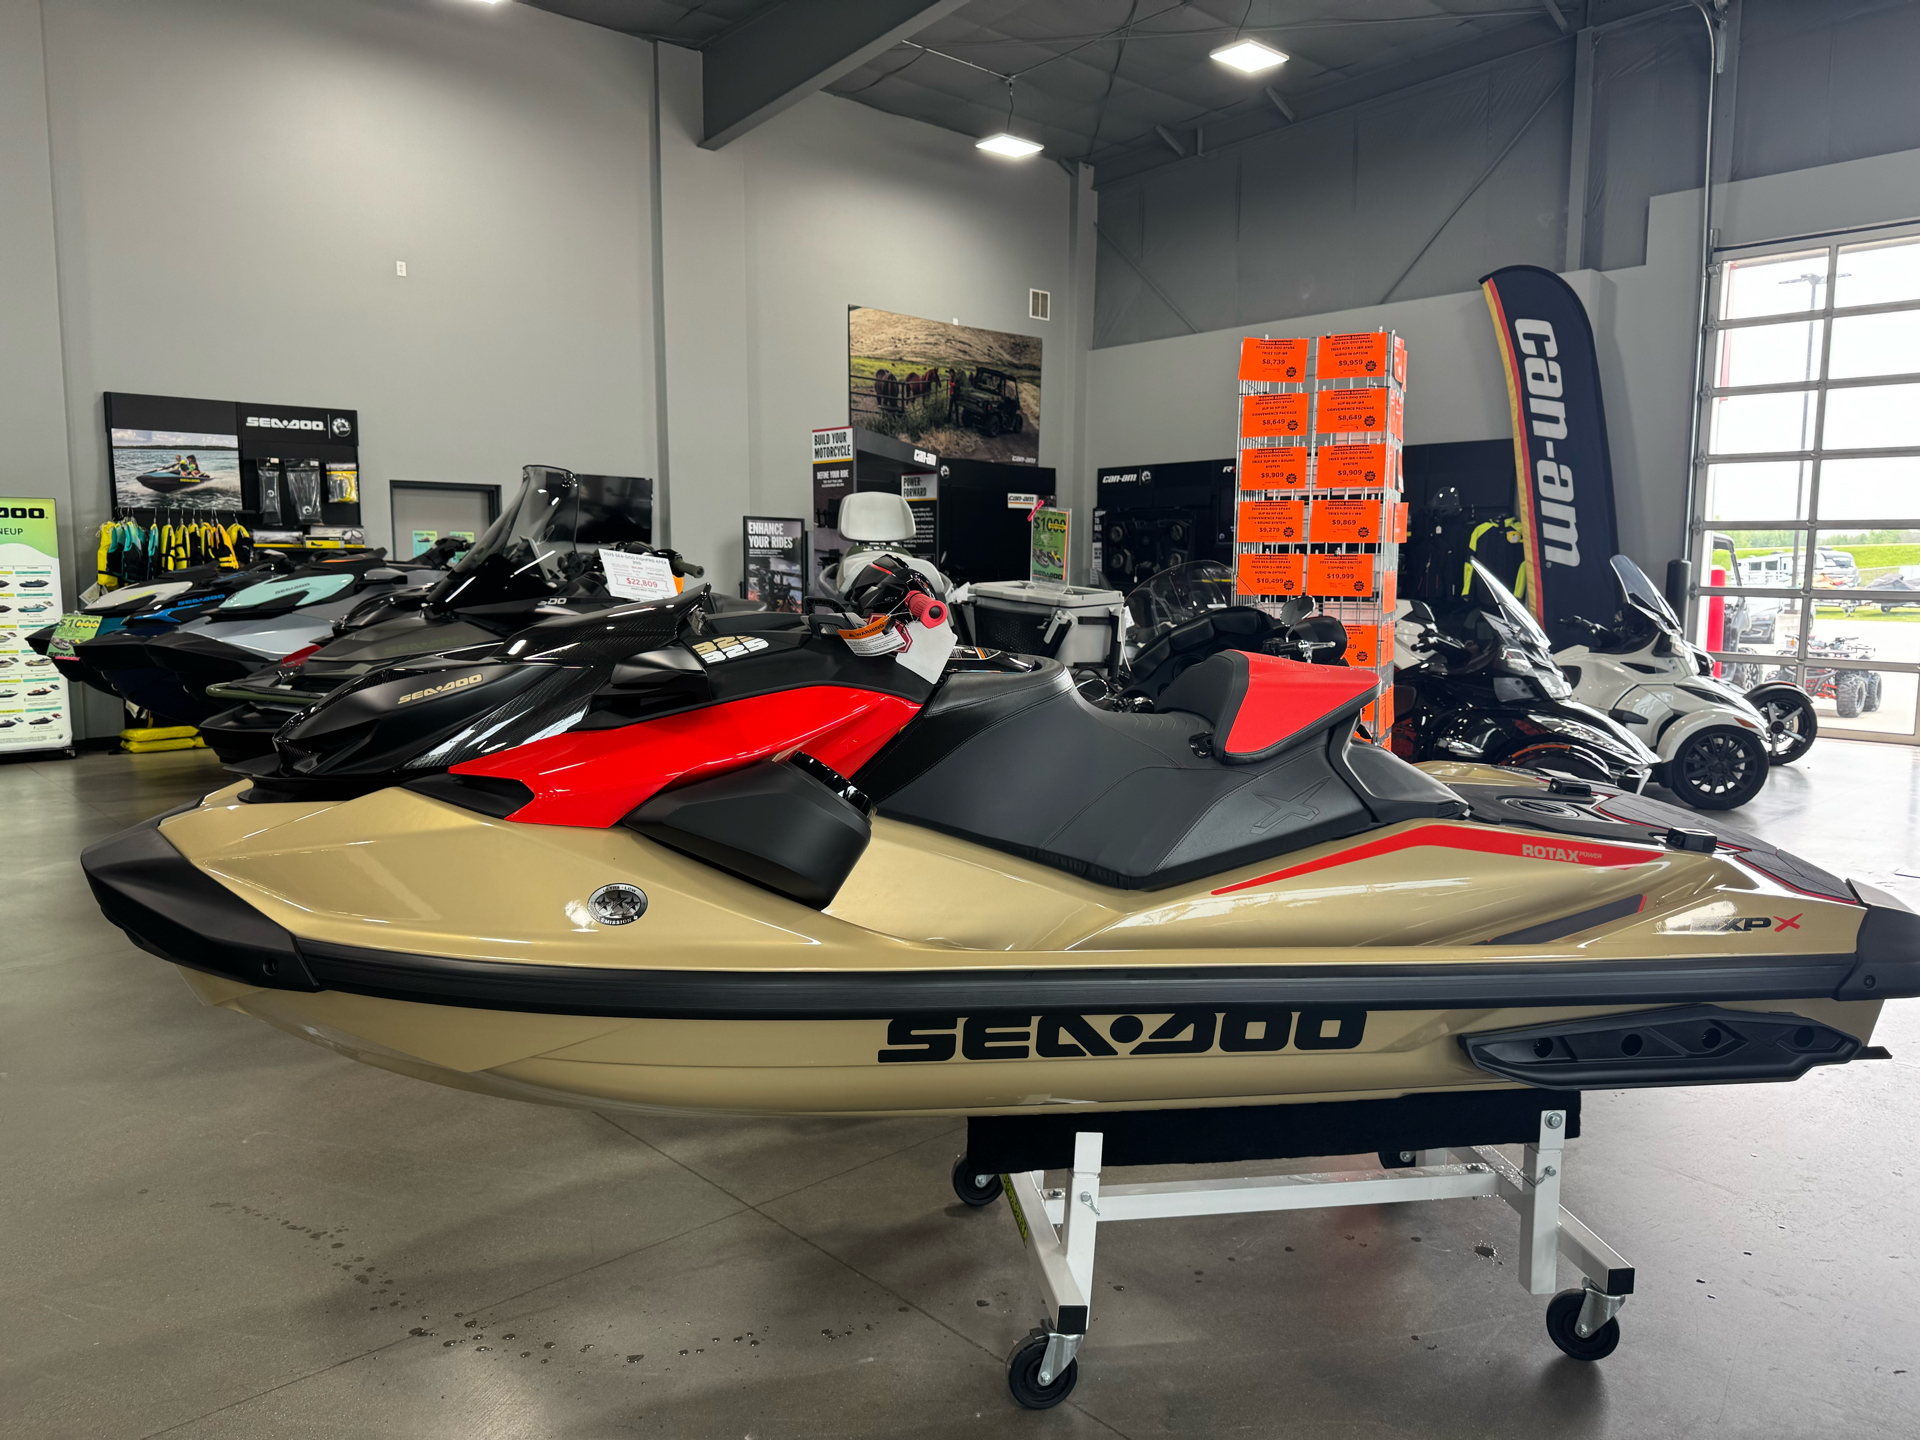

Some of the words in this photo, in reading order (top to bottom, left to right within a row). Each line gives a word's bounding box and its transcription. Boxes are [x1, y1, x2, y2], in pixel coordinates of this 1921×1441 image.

[814, 434, 830, 446] BUILD
[832, 432, 847, 444] YOUR
[1515, 318, 1580, 567] can-am
[814, 444, 850, 458] MOTORCYCLE
[1012, 455, 1036, 464] can-am
[817, 471, 829, 480] DEFINE
[830, 470, 840, 478] YOUR
[840, 469, 849, 478] RIDE
[1102, 474, 1137, 483] can-am
[904, 488, 926, 498] FORWARD
[748, 522, 784, 535] ENHANCE
[748, 536, 770, 548] YOUR
[771, 537, 793, 548] RIDES
[626, 577, 658, 588] $22,809
[856, 623, 885, 638] WARNING
[701, 638, 769, 663] 325
[1522, 844, 1579, 862] ROTAX
